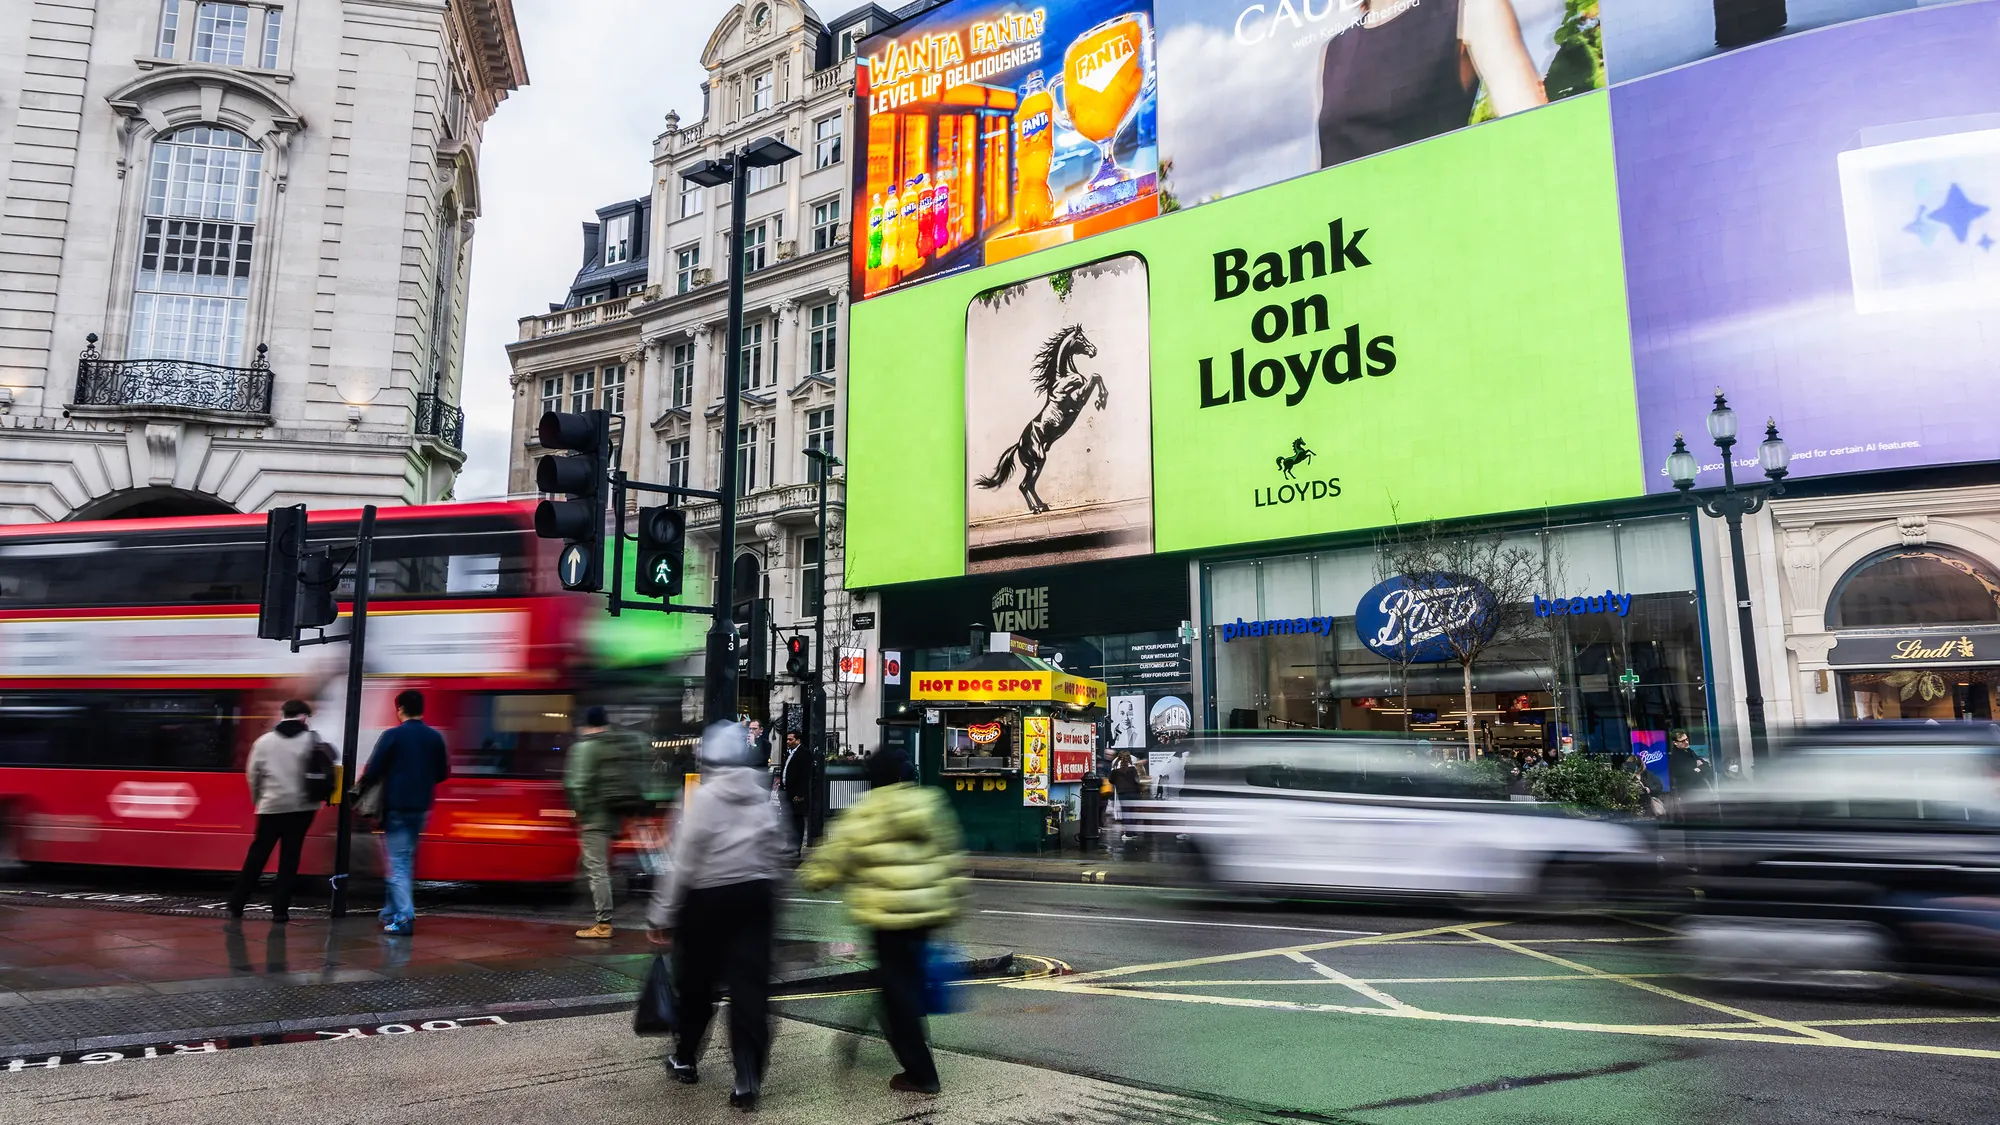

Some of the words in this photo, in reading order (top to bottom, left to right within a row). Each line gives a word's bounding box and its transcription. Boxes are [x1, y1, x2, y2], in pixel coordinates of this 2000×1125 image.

[1234, 0, 1362, 46] CAU
[1291, 35, 1316, 49] with
[1319, 22, 1350, 37] Kelly
[869, 33, 963, 88] WANTA
[971, 10, 1045, 53] FANTA?
[1076, 35, 1135, 82] FANTA
[869, 82, 918, 116] LEVEL
[922, 73, 942, 98] UP
[945, 42, 1041, 91] DELICIOUSNESS
[1022, 112, 1049, 134] FANTA
[1212, 217, 1372, 302] Bank
[1251, 294, 1330, 344] on
[1198, 323, 1397, 409] Lloyds
[205, 426, 265, 439] LIFE
[1814, 449, 1827, 458] for
[1830, 444, 1864, 456] certain
[1866, 443, 1876, 452] AI
[1878, 440, 1921, 451] features.
[1254, 478, 1341, 507] LLOYDS
[1015, 586, 1049, 610] THE
[1533, 590, 1632, 617] beauty
[992, 608, 1049, 632] VENUE
[1223, 615, 1333, 642] pharmacy
[1370, 586, 1477, 647] Boots
[1891, 639, 1957, 659] Lindt
[919, 679, 953, 692] HOT
[958, 679, 993, 692] DOG
[998, 679, 1043, 692] SPOT
[1064, 681, 1074, 695] HOT
[1075, 683, 1085, 696] DOG
[1086, 686, 1098, 699] SPOT
[971, 732, 984, 741] HOT
[985, 730, 998, 741] DOG
[1063, 734, 1071, 744] HOT
[1062, 763, 1070, 774] ICE
[1070, 763, 1083, 774] CREAM
[1640, 750, 1663, 764] Boots
[316, 1015, 510, 1040] LOOK
[0, 1039, 218, 1072] RIGH
